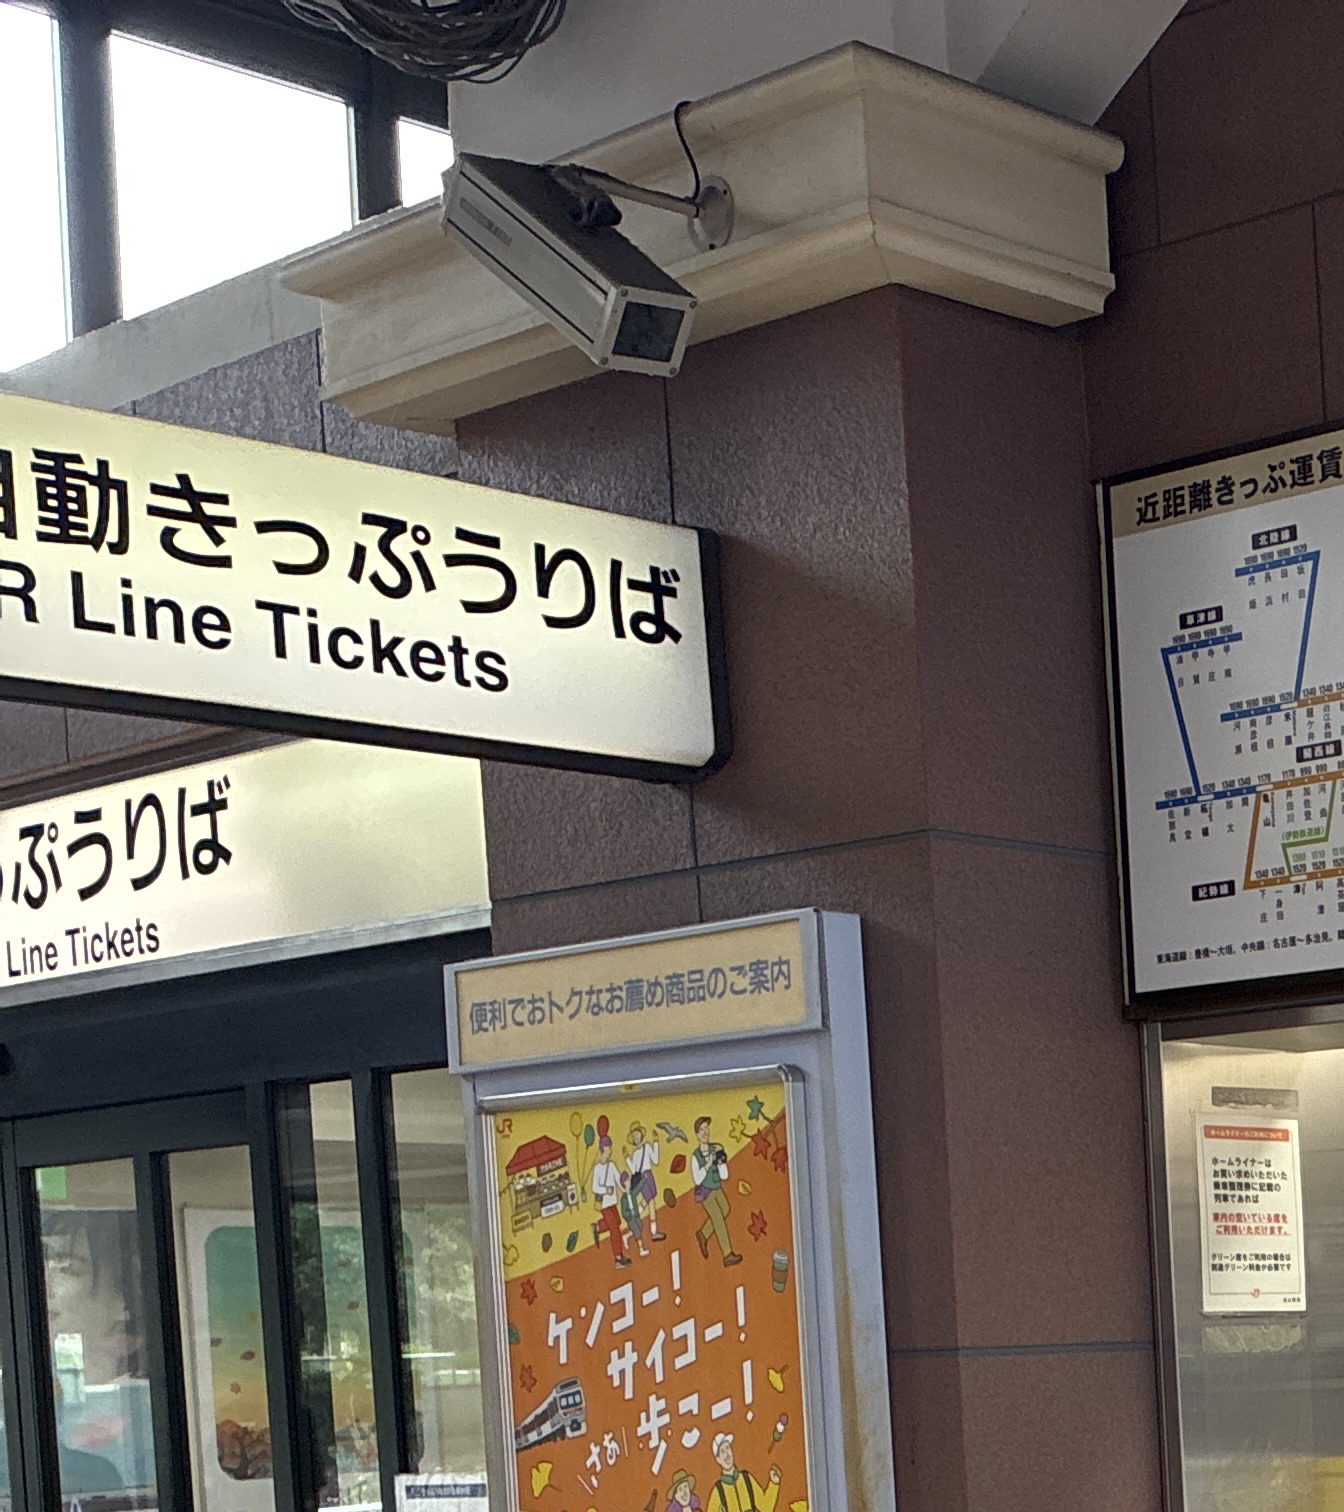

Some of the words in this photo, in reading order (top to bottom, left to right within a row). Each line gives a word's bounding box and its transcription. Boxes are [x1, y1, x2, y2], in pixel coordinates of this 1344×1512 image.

[0, 447, 683, 645] 動きっぷうりば
[70, 569, 232, 651] Line
[254, 600, 510, 692] Tickets
[0, 774, 232, 910] ぷうりば
[6, 937, 59, 977] Line
[65, 918, 160, 966] Tickets
[1211, 1157, 1271, 1168] ホームライナーは
